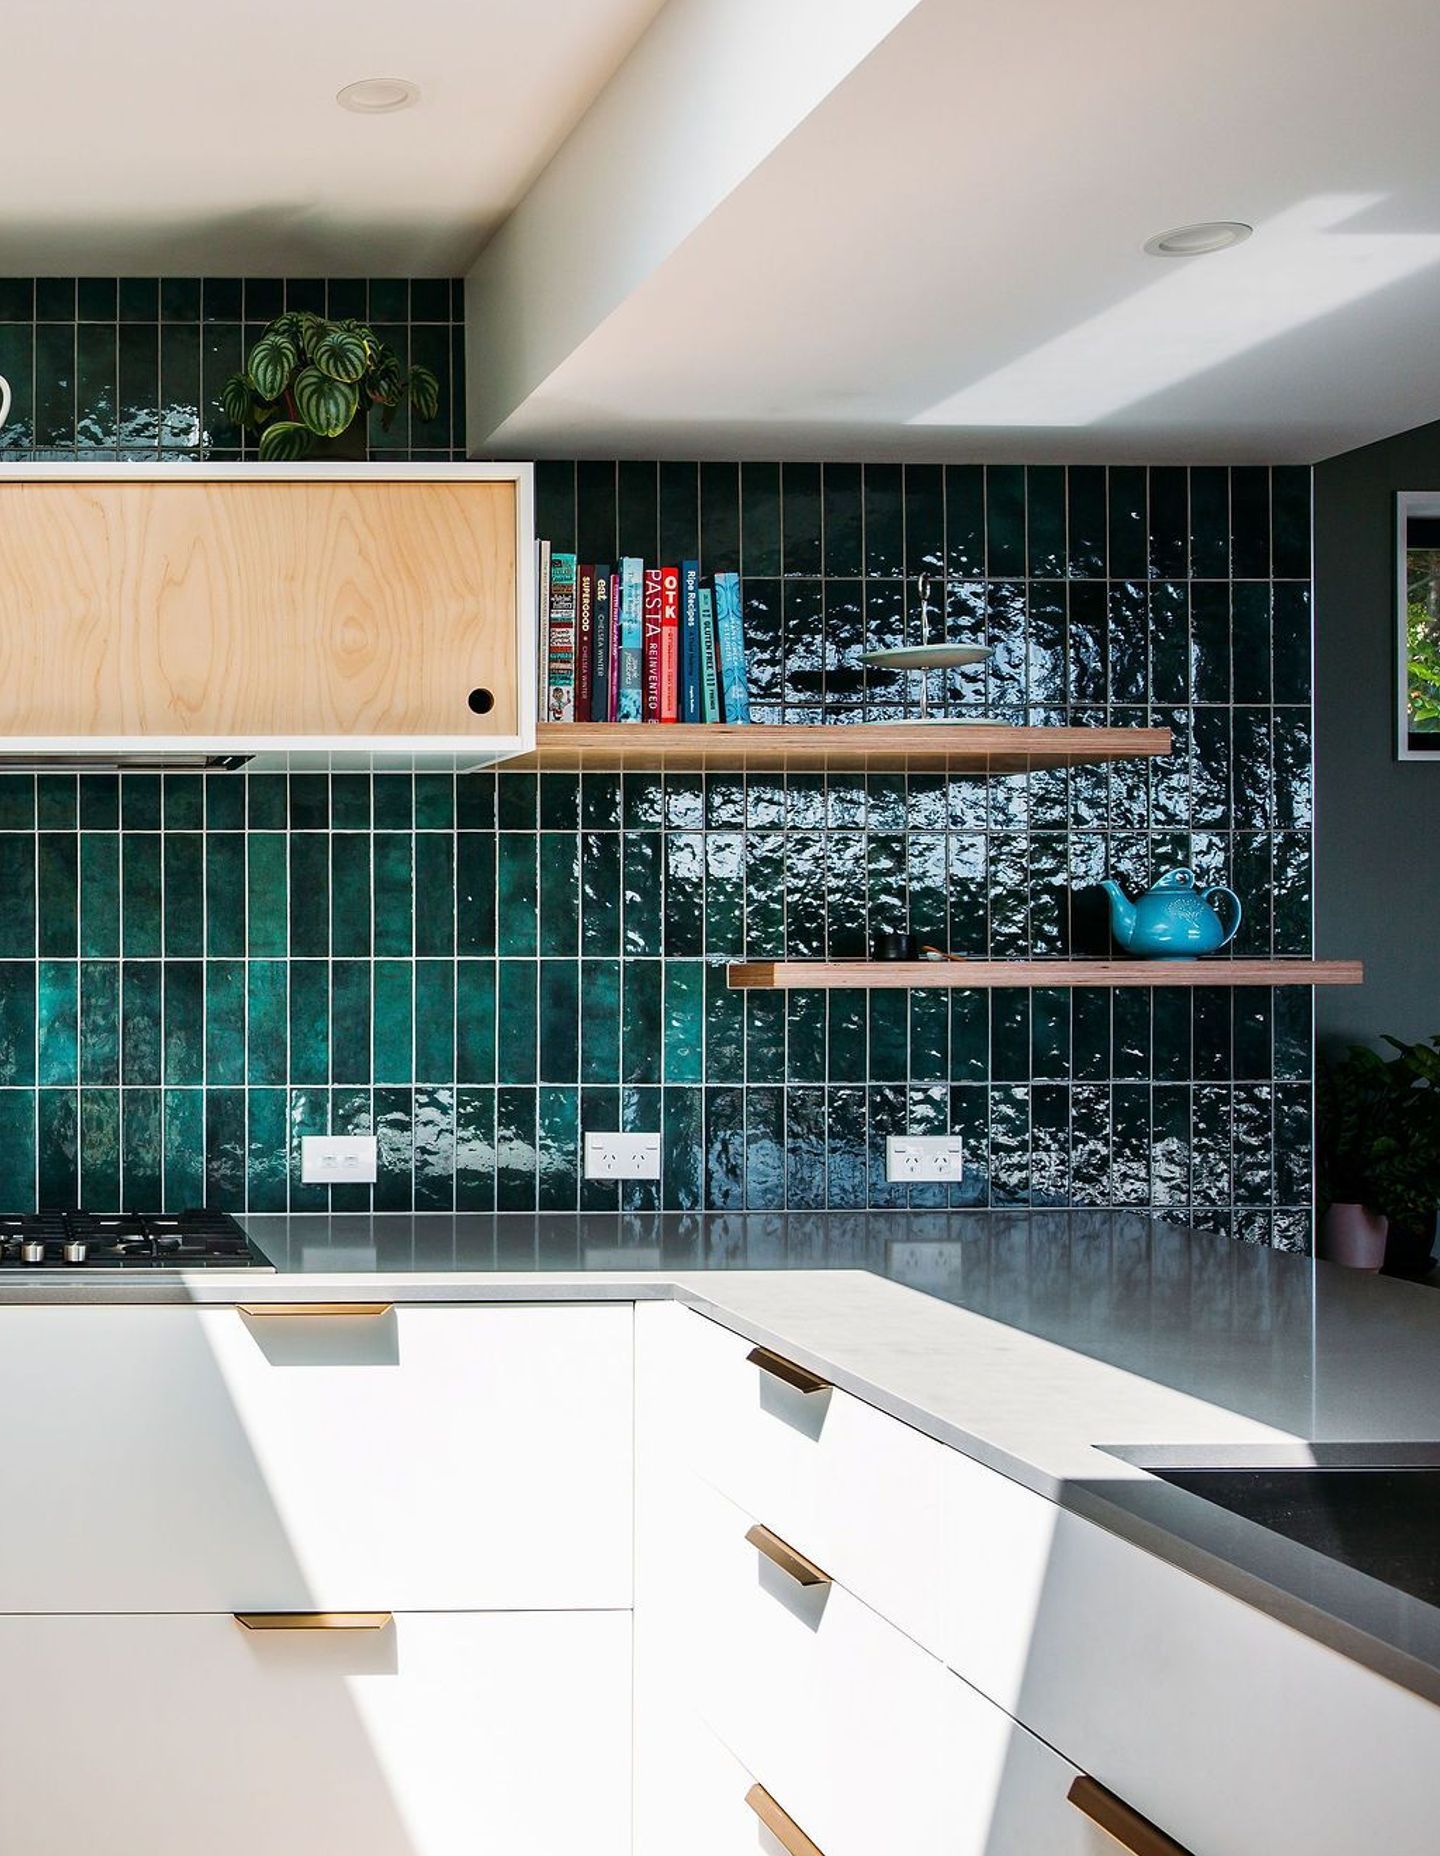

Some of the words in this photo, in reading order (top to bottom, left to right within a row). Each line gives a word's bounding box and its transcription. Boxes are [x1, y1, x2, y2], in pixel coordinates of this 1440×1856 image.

[597, 579, 607, 601] eat
[664, 576, 677, 619] OTK
[687, 571, 696, 591] Ripe
[582, 576, 591, 632] SUPERGOOD
[645, 569, 662, 637] PASTA
[687, 593, 696, 627] Recipes
[597, 613, 605, 647] CHELSEA
[703, 620, 713, 650] GLUTEN
[648, 643, 658, 709] REINVENTED
[706, 651, 714, 671] FREE
